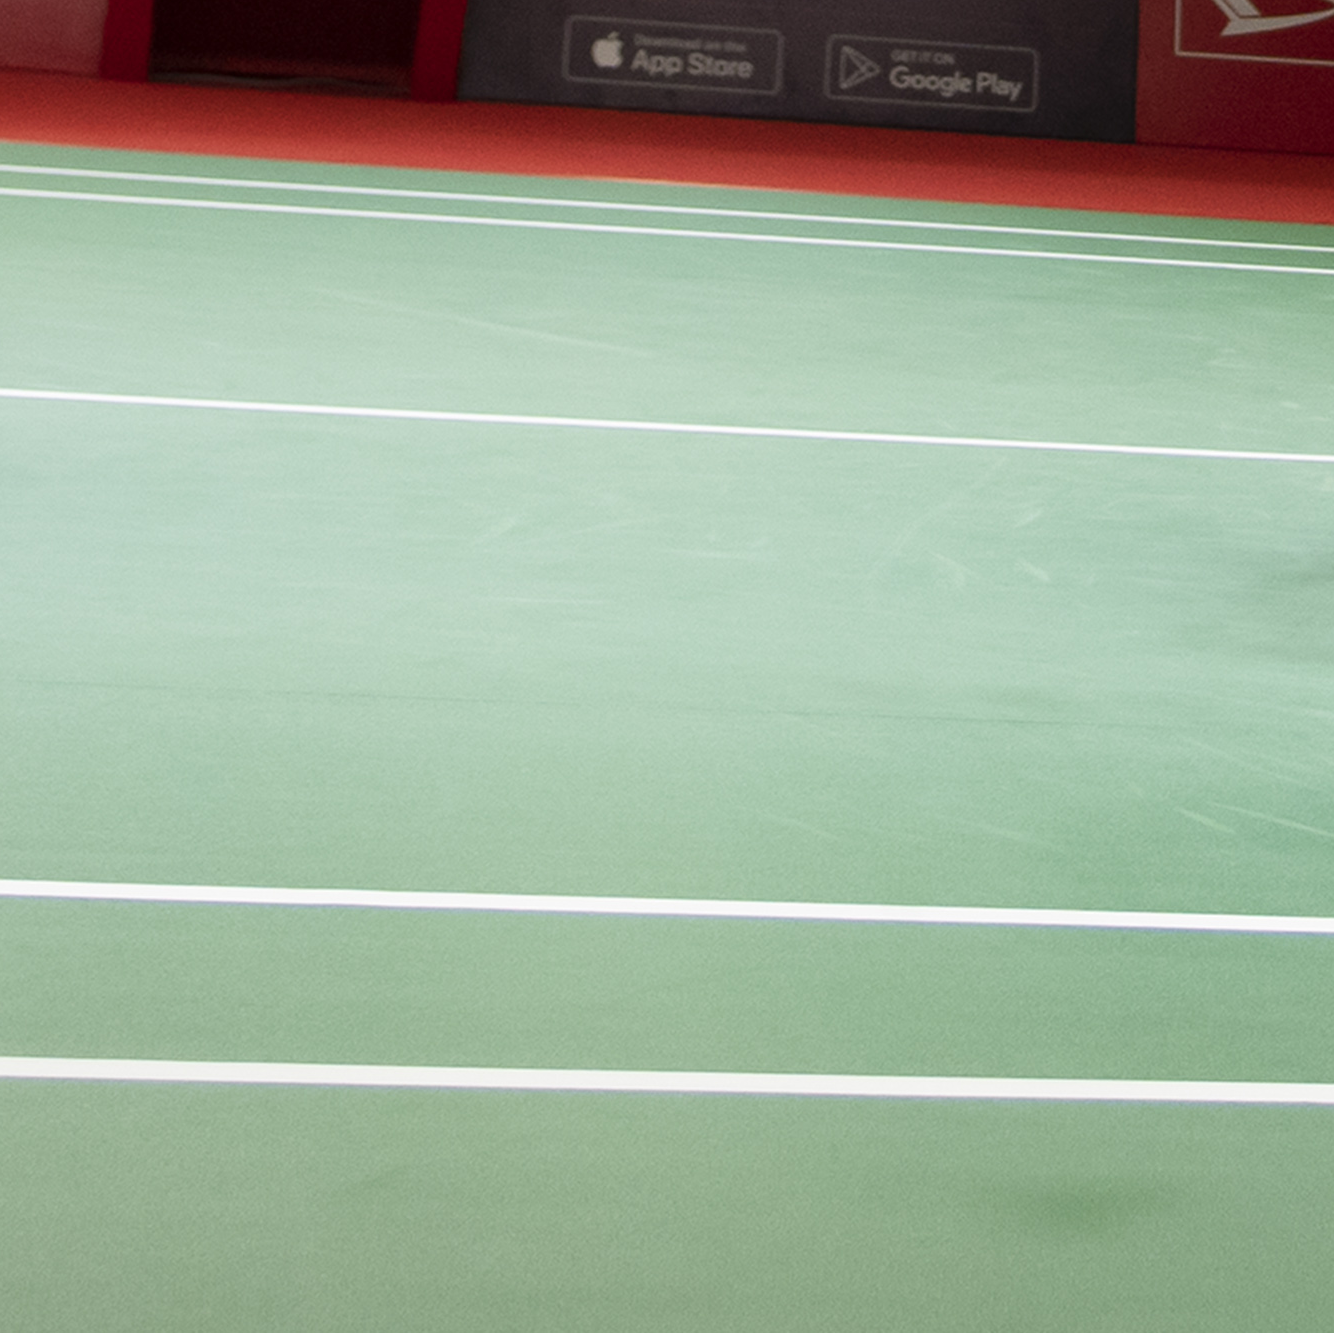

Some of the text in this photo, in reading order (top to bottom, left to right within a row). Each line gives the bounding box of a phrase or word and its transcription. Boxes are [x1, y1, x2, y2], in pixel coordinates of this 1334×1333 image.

[630, 47, 755, 79] App Store
[888, 64, 1025, 103] Google Play
